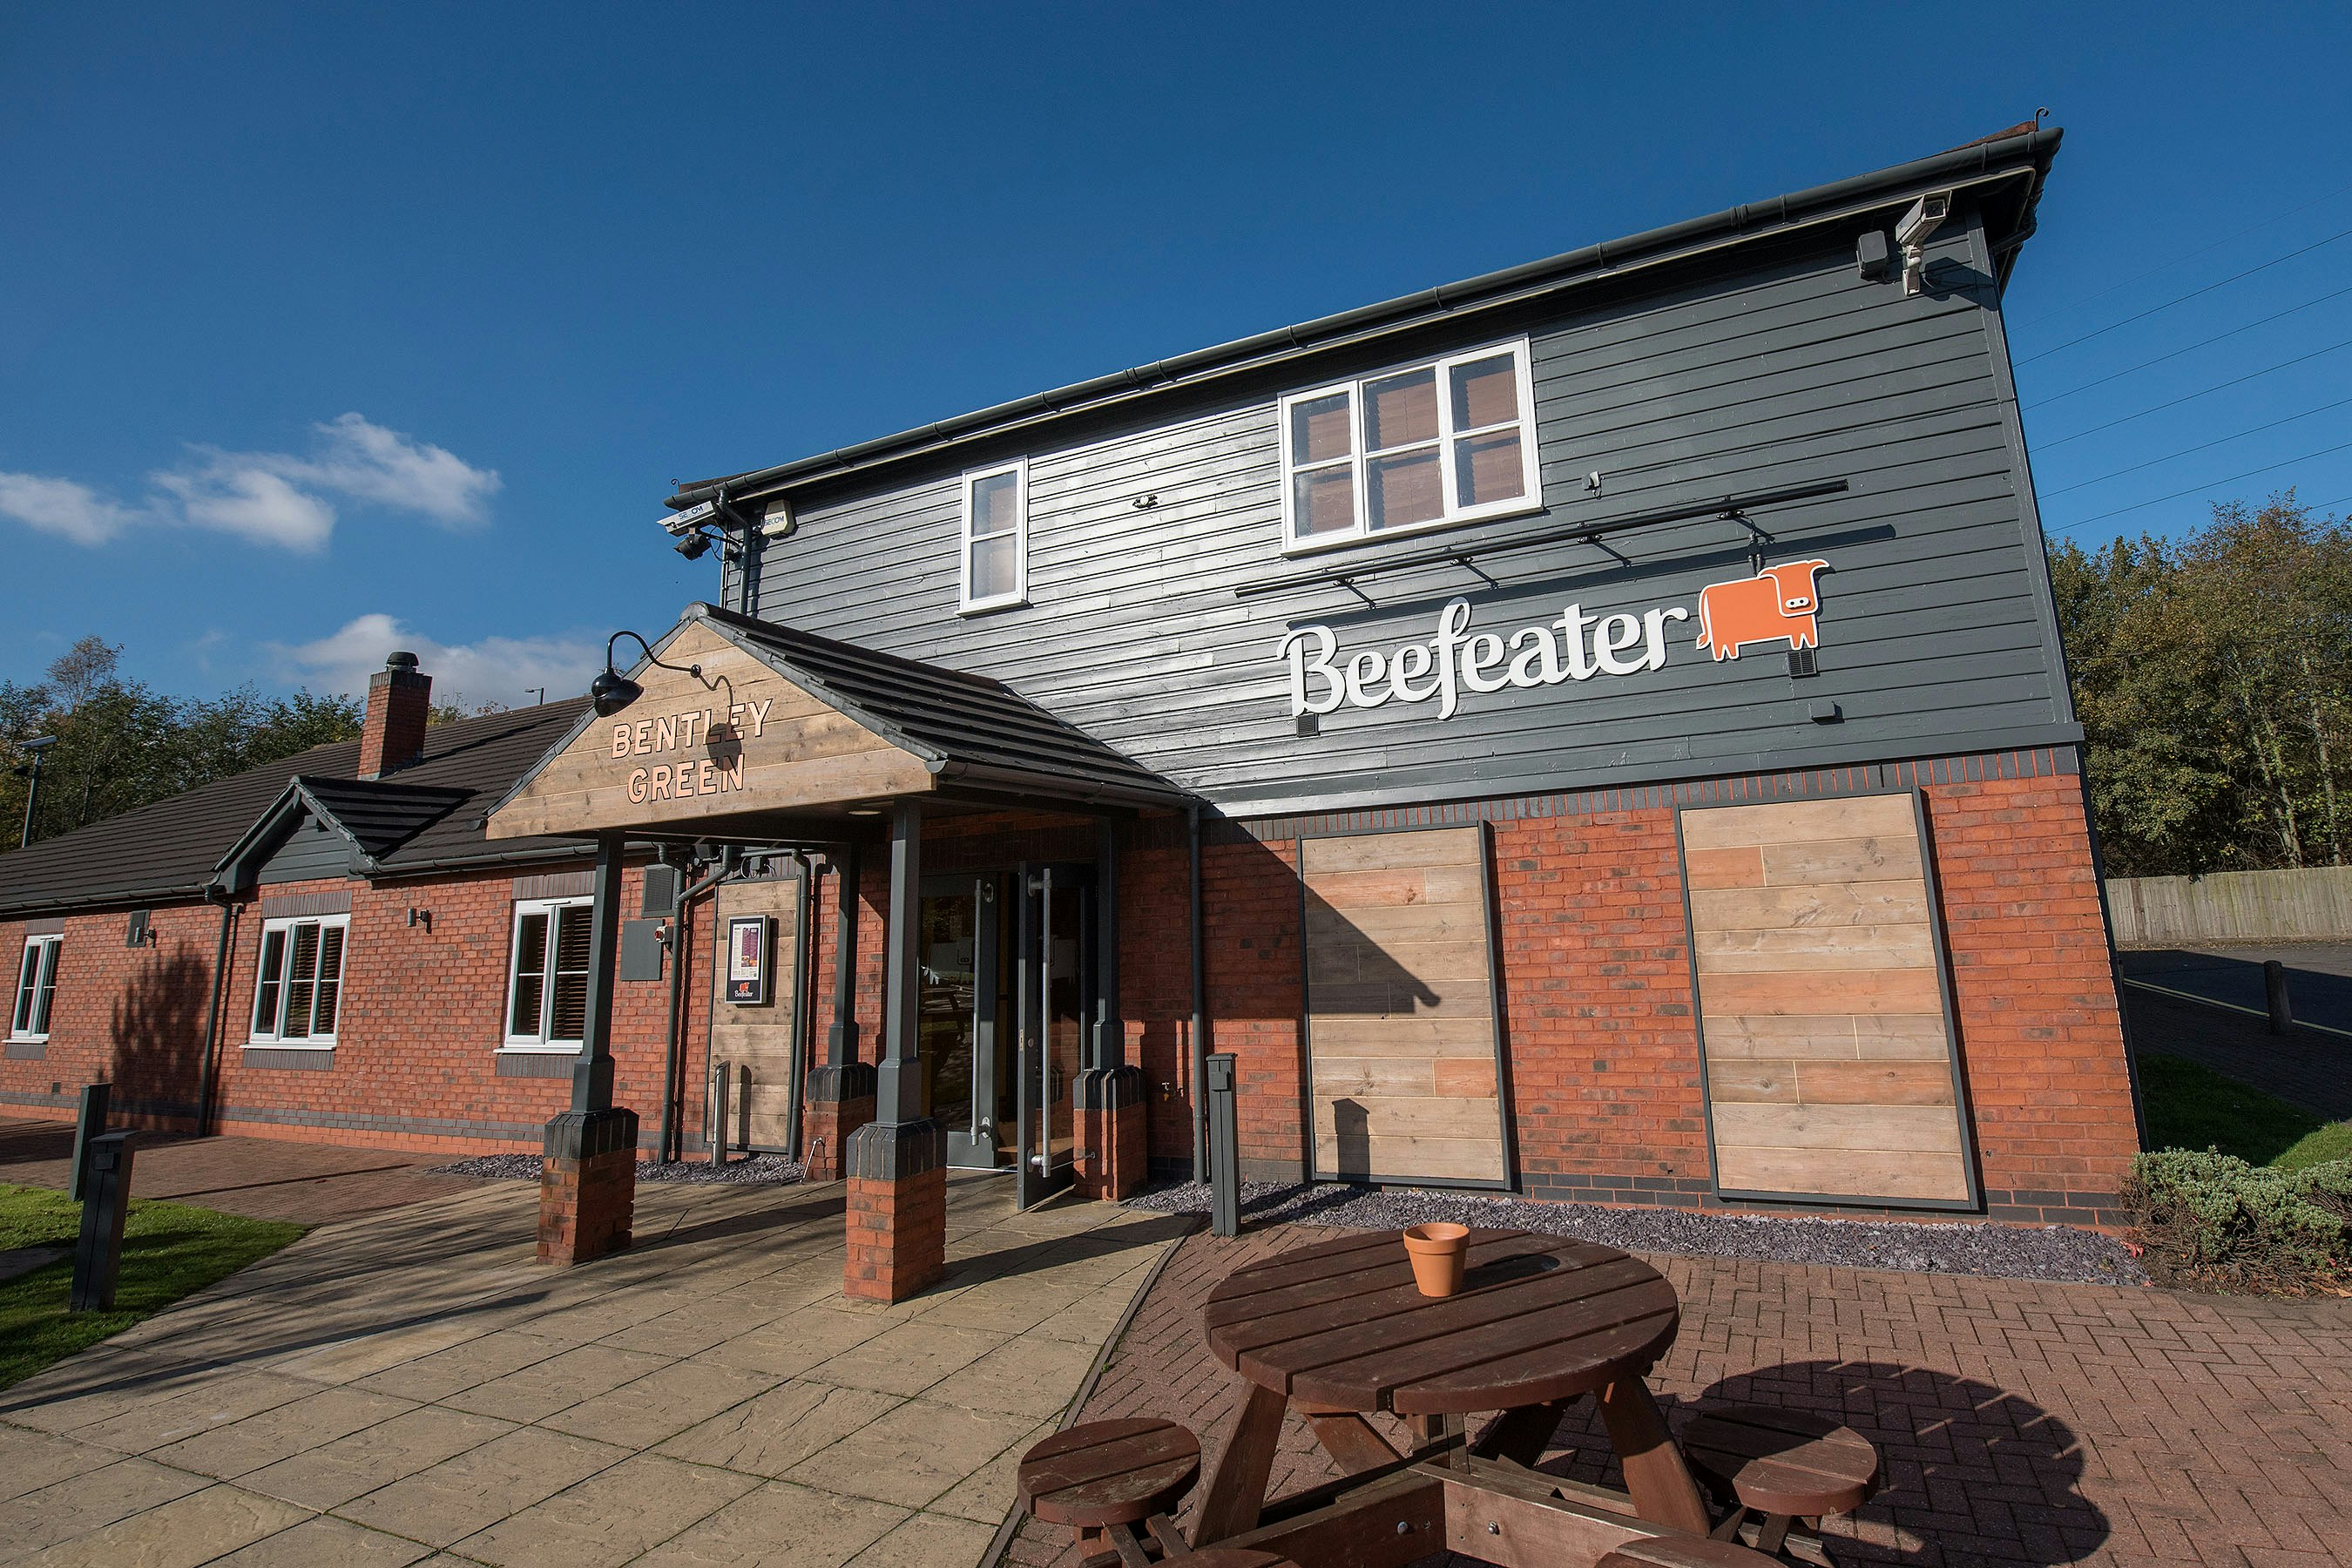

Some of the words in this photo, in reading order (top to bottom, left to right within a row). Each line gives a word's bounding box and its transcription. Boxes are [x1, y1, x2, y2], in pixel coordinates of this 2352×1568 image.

[679, 505, 704, 520] SEOM
[1276, 596, 1688, 720] Beefeater
[612, 699, 774, 759] BENTLEY
[627, 754, 745, 804] GREEN
